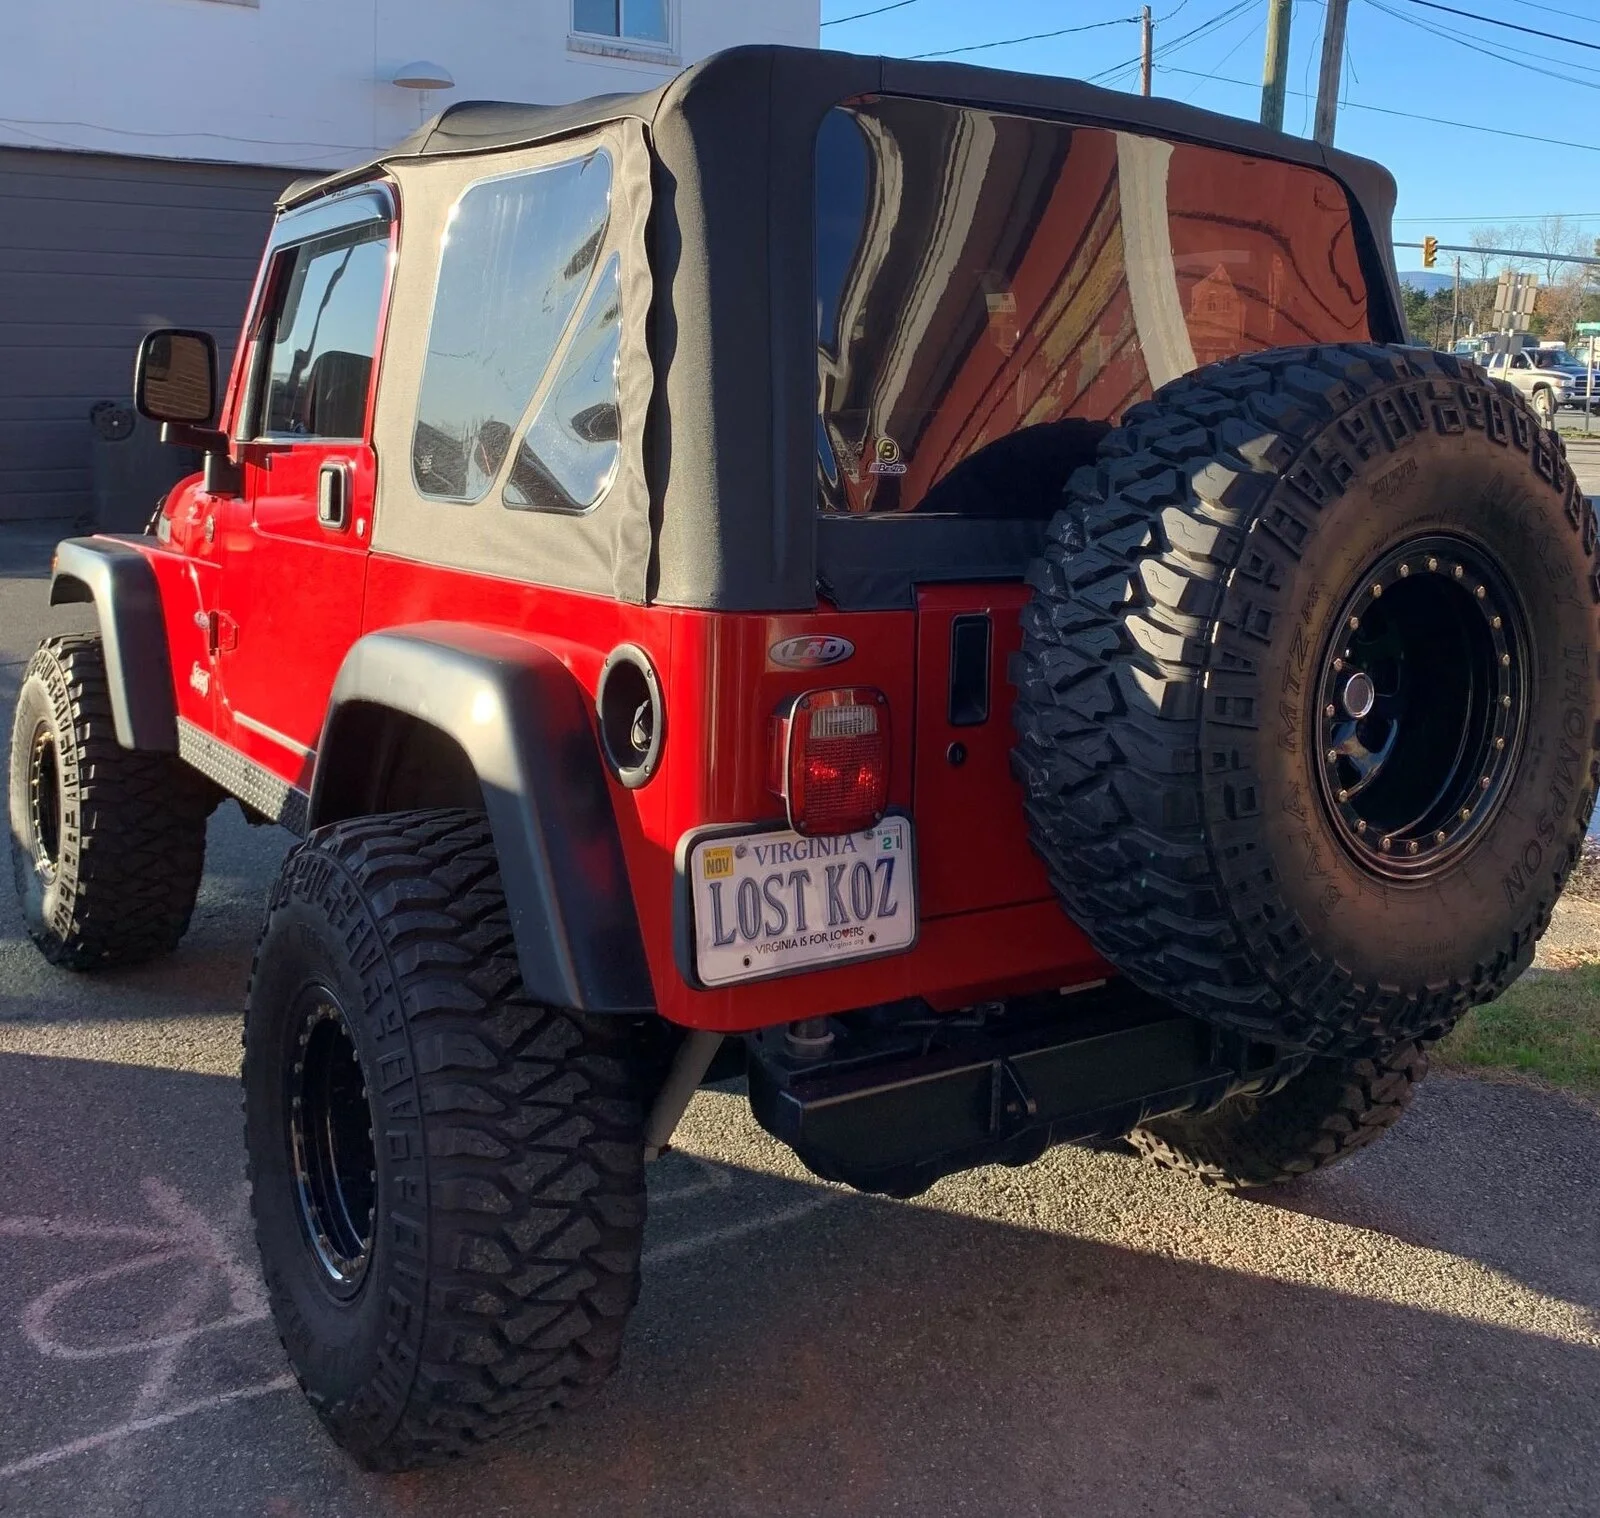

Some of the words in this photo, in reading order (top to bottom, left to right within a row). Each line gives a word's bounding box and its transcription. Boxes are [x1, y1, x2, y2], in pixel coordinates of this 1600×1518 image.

[1502, 640, 1590, 909] THOMPSON
[705, 857, 729, 876] NOV
[754, 834, 859, 867] VIRGINIA
[709, 869, 811, 947] LOST
[825, 856, 898, 927] KOZ
[755, 938, 799, 955] VIRGINIA
[799, 935, 808, 947] IS
[809, 932, 829, 946] FOR
